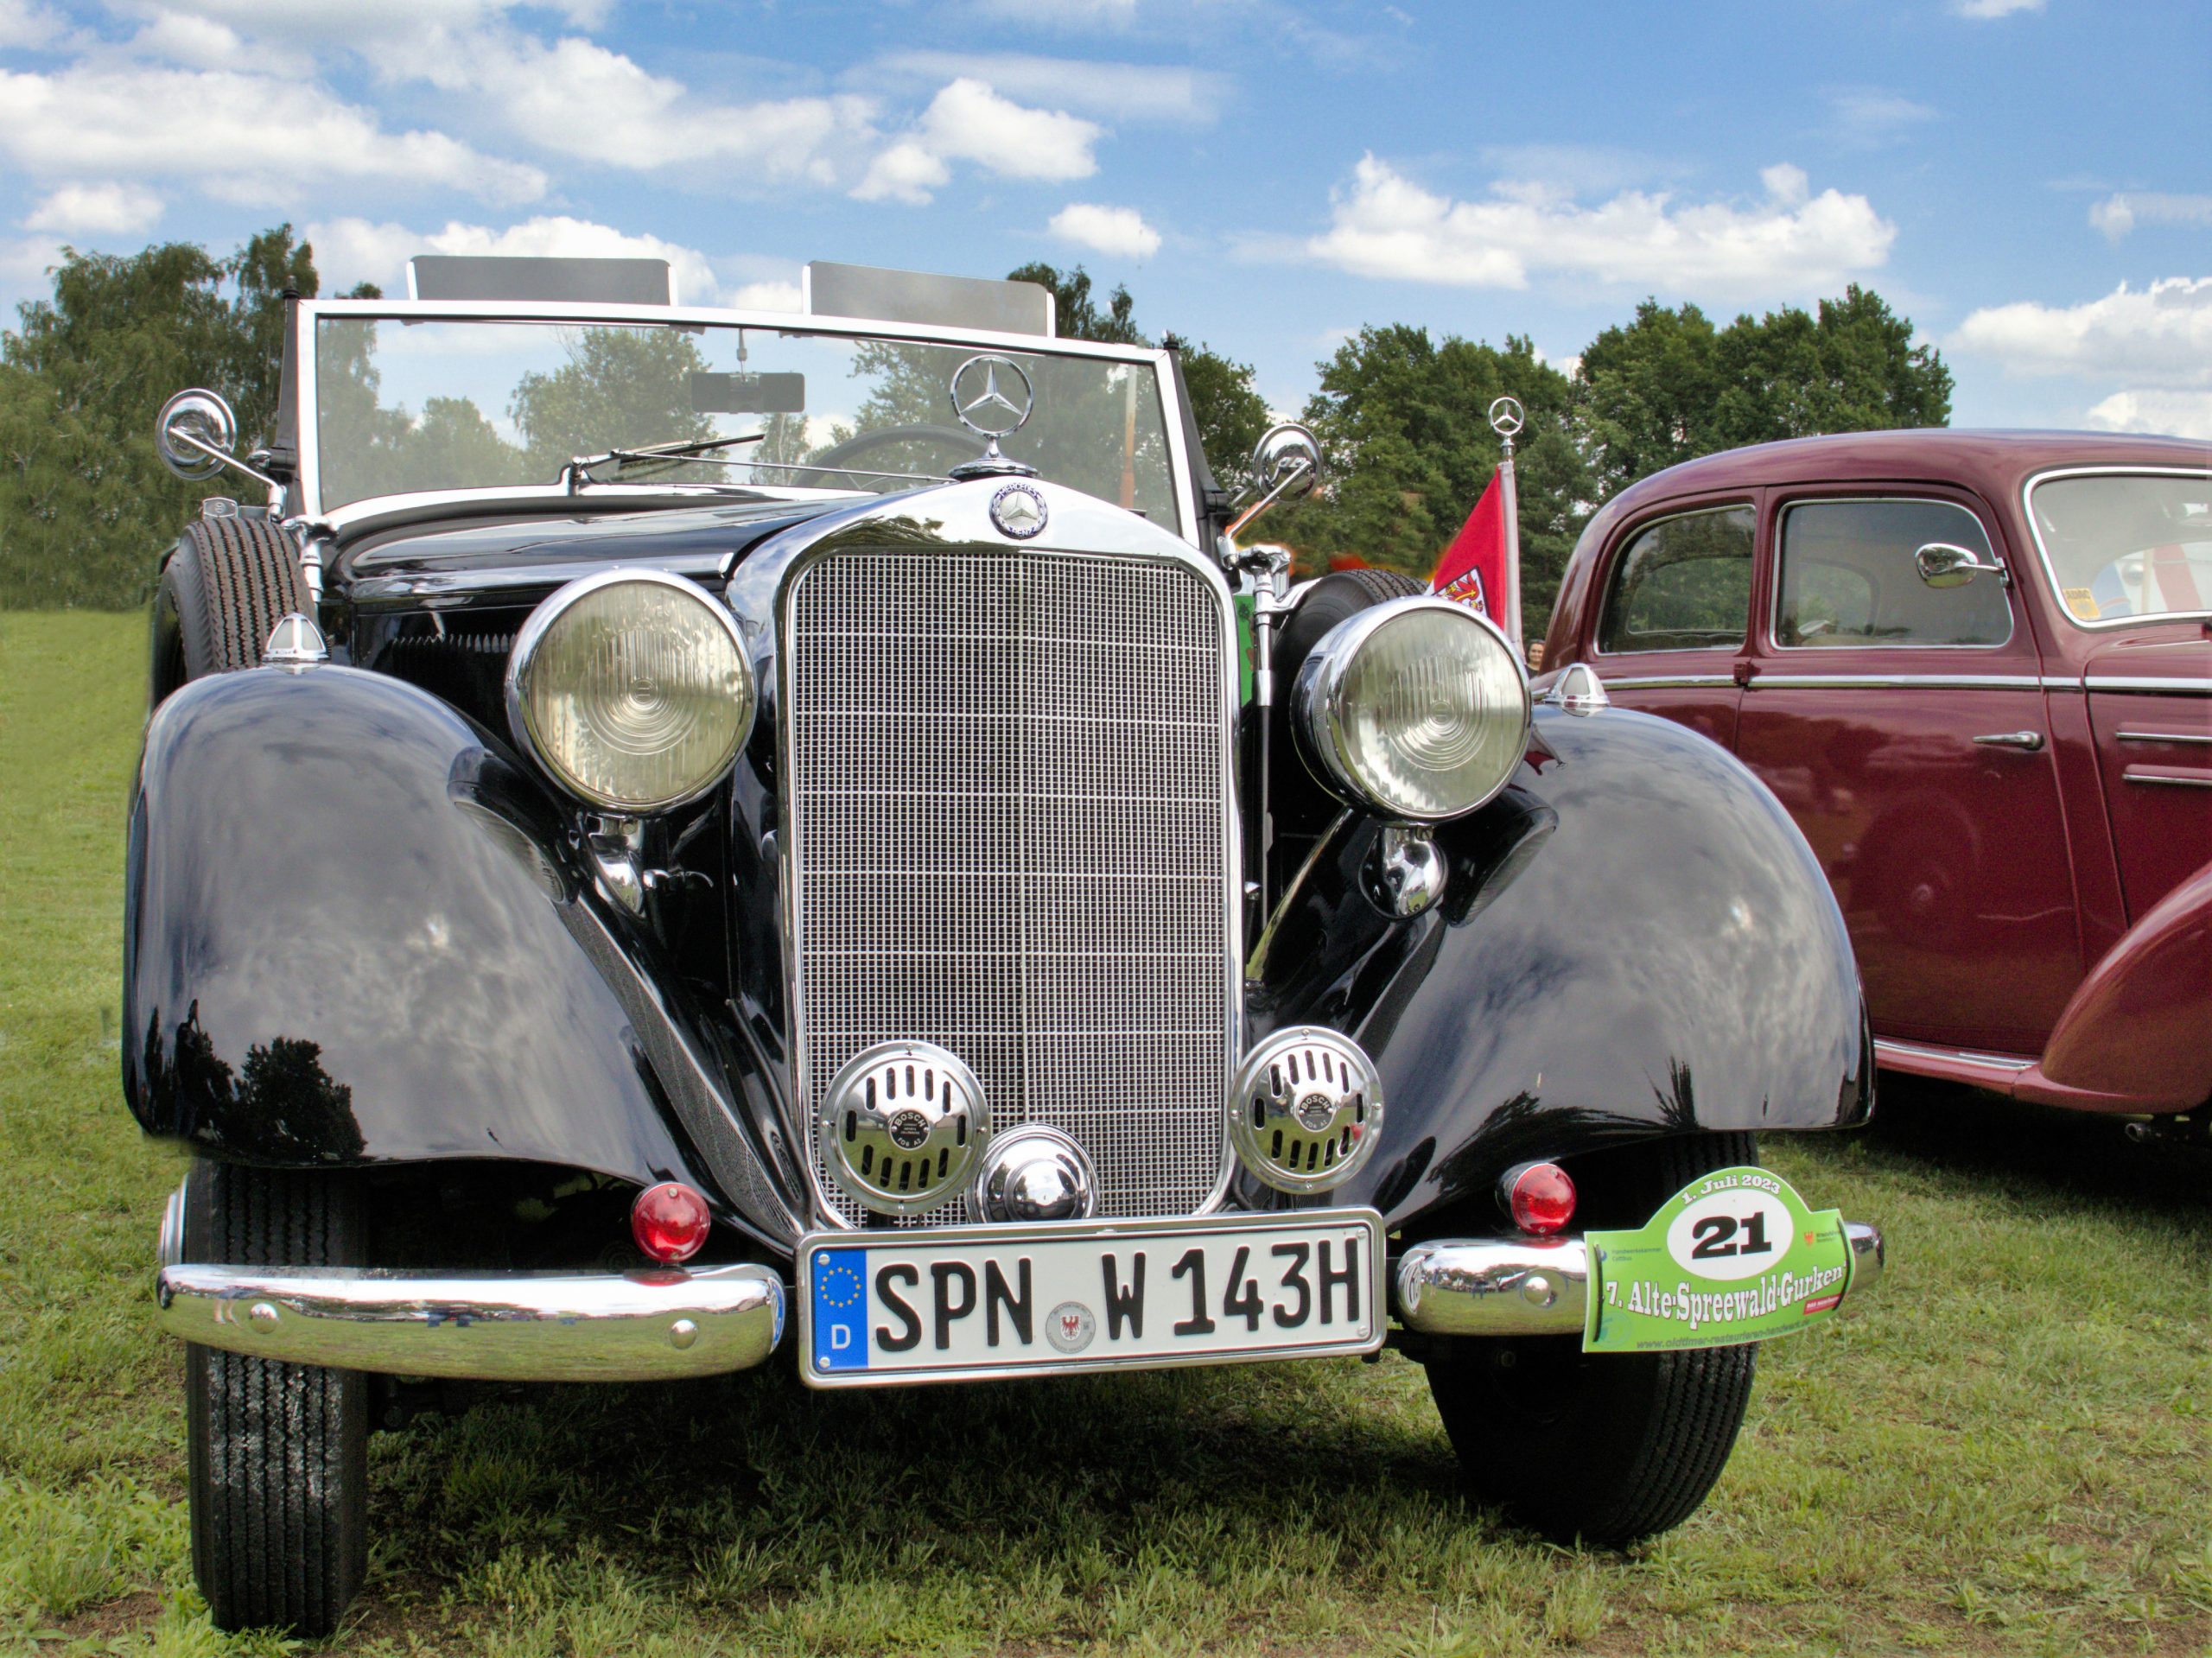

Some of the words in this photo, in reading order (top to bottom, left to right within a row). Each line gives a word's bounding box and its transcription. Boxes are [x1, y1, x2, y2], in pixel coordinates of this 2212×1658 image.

[998, 483, 1038, 498] MERCEDES
[1013, 526, 1034, 536] BENZ
[1301, 1095, 1331, 1109] BOSCH
[894, 1112, 926, 1128] BOSCH
[1681, 1192, 1697, 1205] 1.
[1700, 1175, 1738, 1195] Juli
[1741, 1174, 1781, 1195] 2023
[1692, 1211, 1772, 1260] 21
[874, 1258, 1033, 1354] SPN
[1101, 1252, 1147, 1342] W
[1171, 1237, 1361, 1337] 143H
[1605, 1280, 1624, 1308] 7.
[830, 1324, 851, 1350] D
